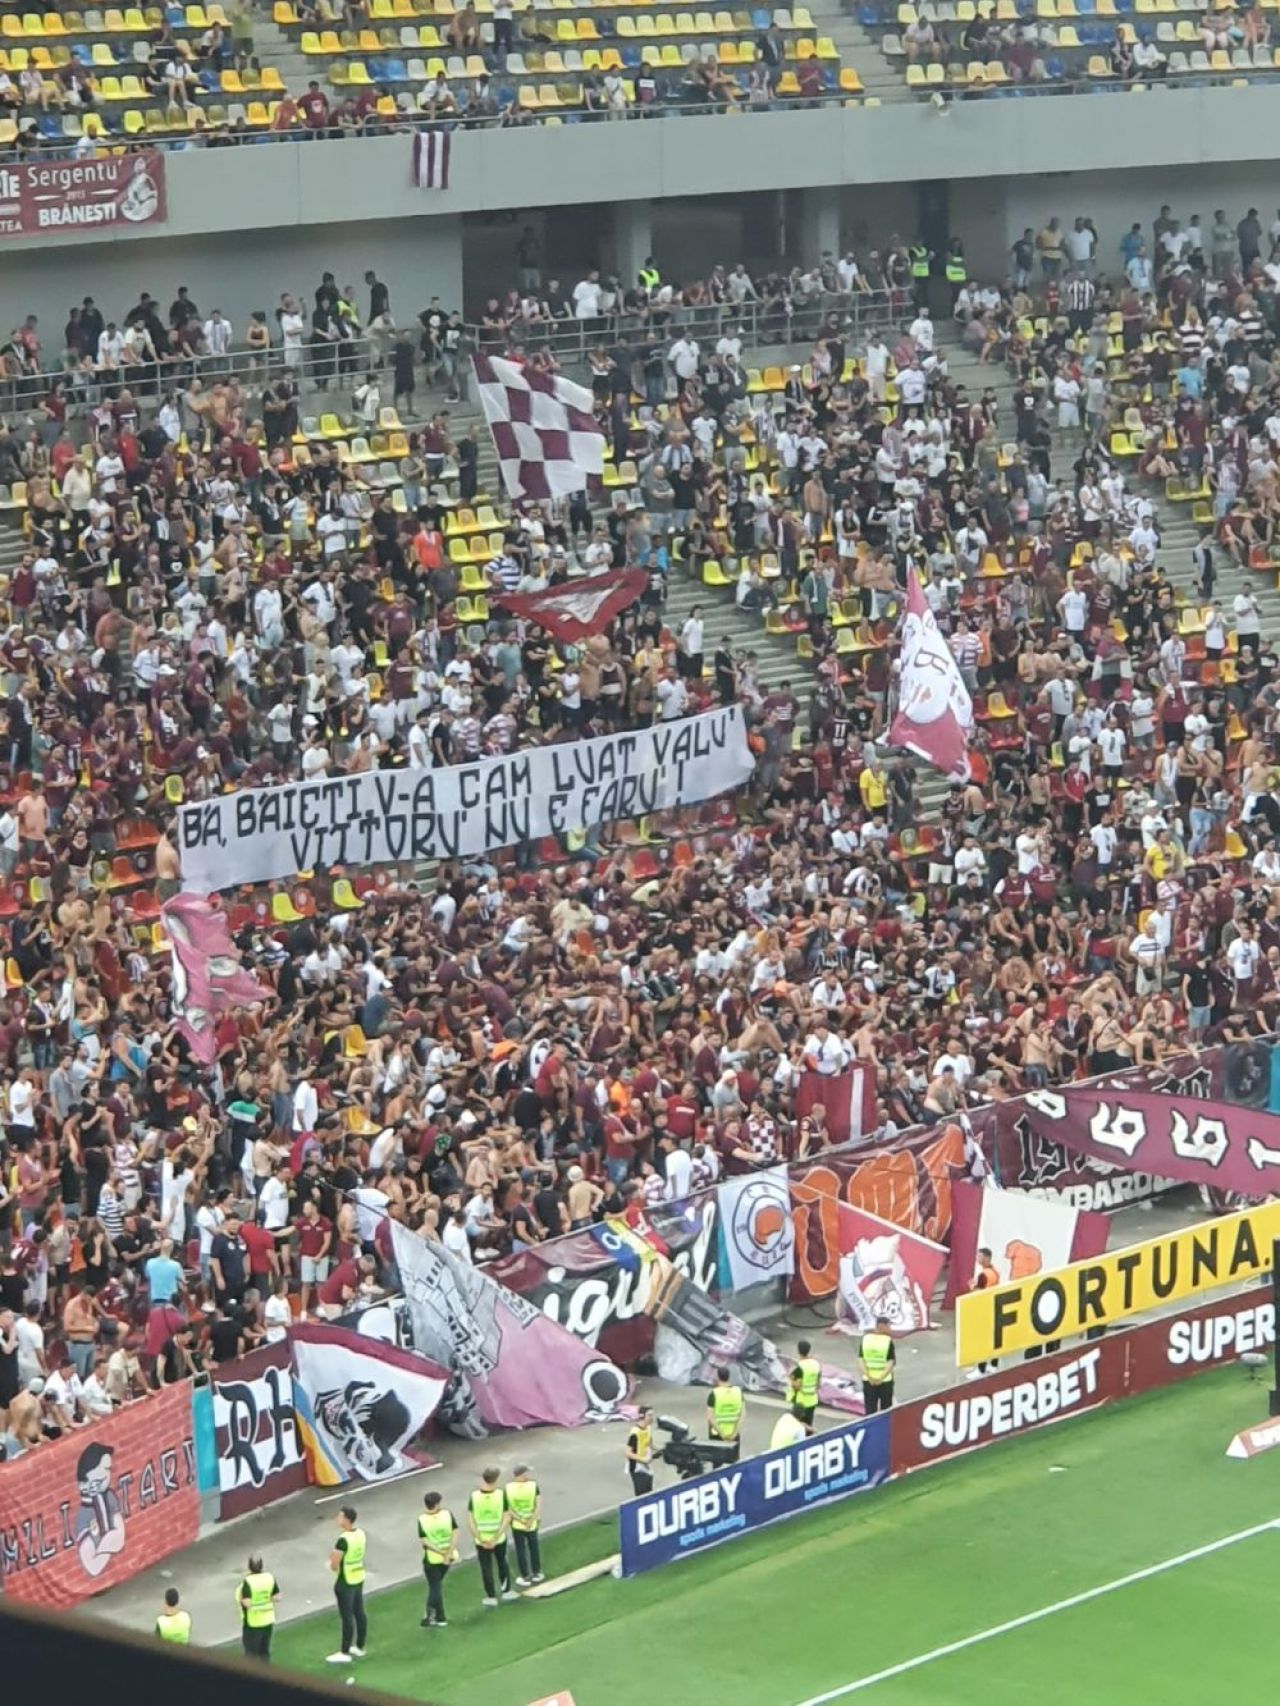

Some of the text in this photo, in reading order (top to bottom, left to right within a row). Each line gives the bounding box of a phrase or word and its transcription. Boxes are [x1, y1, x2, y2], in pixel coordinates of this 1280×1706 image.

[459, 756, 532, 808] CAM
[552, 737, 636, 791] LUAT
[485, 797, 530, 848] NU
[548, 794, 568, 832] E
[920, 1348, 1101, 1449] SUPERBET
[764, 1429, 866, 1499] DURBY
[637, 1473, 742, 1545] DURBY
